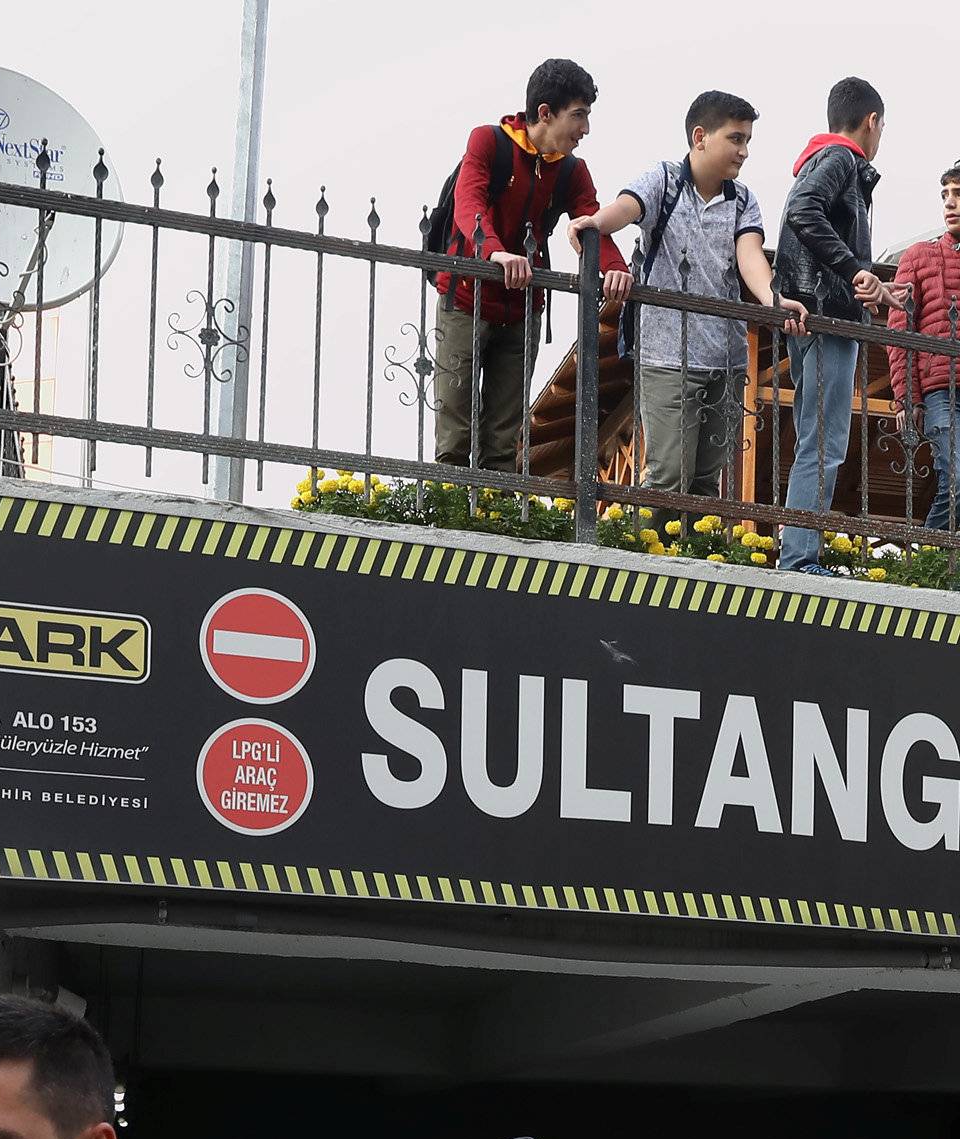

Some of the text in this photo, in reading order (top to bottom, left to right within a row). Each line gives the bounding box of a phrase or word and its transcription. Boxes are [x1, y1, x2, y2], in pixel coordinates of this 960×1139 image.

[12, 711, 54, 731] ALO
[60, 715, 97, 734] 153
[235, 765, 277, 792] ARAÇ
[41, 791, 149, 810] BELEDİYESİ
[221, 788, 288, 814] GİREMEZ
